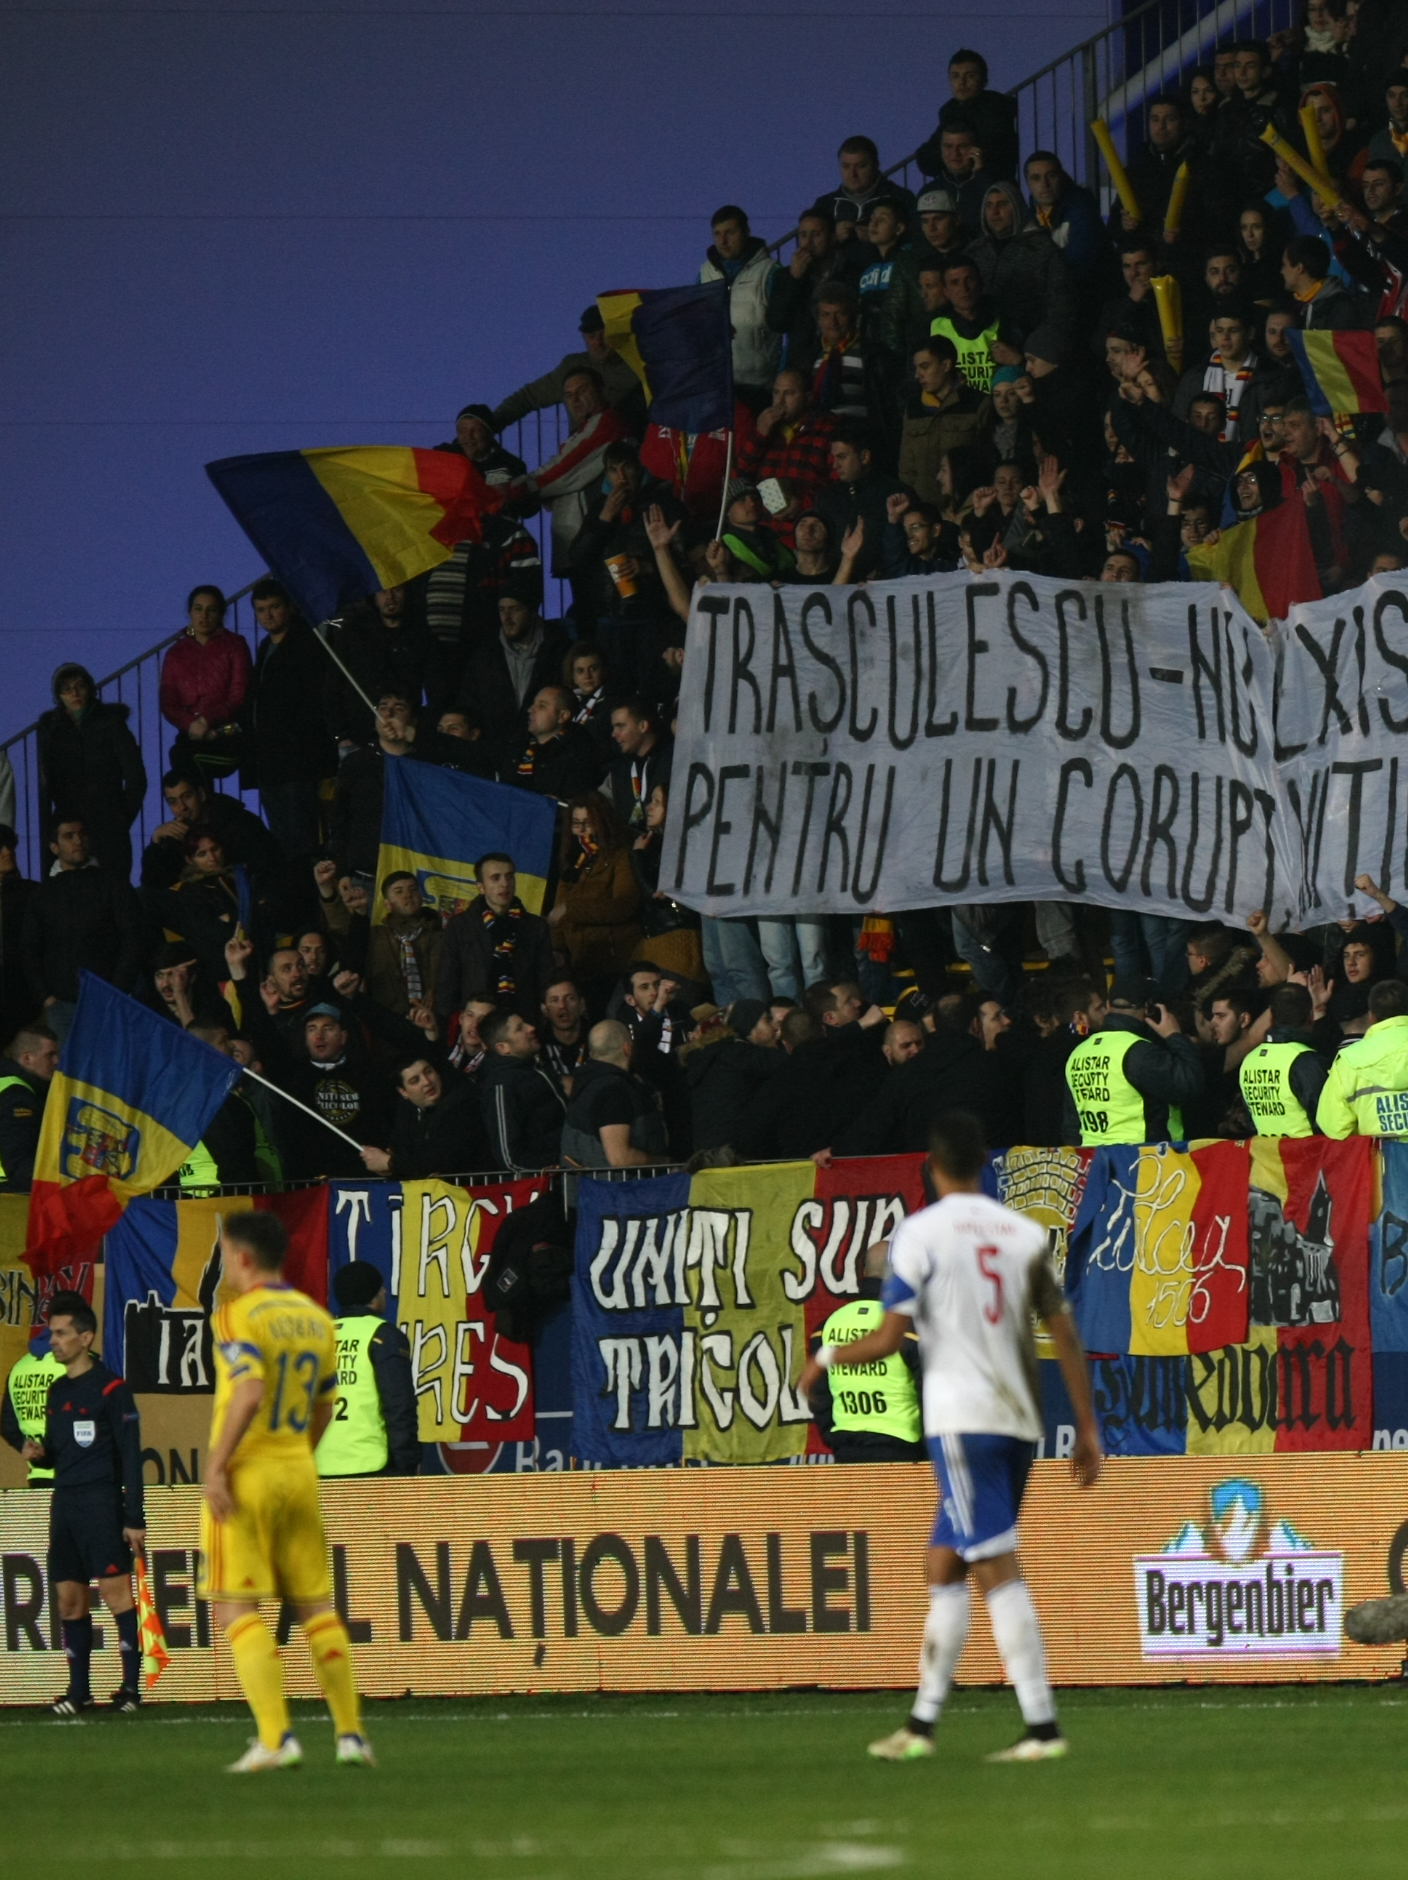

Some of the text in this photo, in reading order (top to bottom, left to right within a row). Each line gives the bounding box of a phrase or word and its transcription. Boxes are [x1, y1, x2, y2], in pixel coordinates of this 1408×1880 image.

[674, 761, 896, 904] PENTRU
[933, 757, 1021, 893] UN
[1070, 1055, 1111, 1073] ALISTAR
[1243, 1069, 1281, 1085] ALISTAR
[1244, 1085, 1281, 1102] SECURITY
[974, 1245, 1006, 1328] 5
[268, 1350, 321, 1433] 13
[838, 1390, 888, 1416] 1306
[1145, 1560, 1335, 1648] Bergenbier
